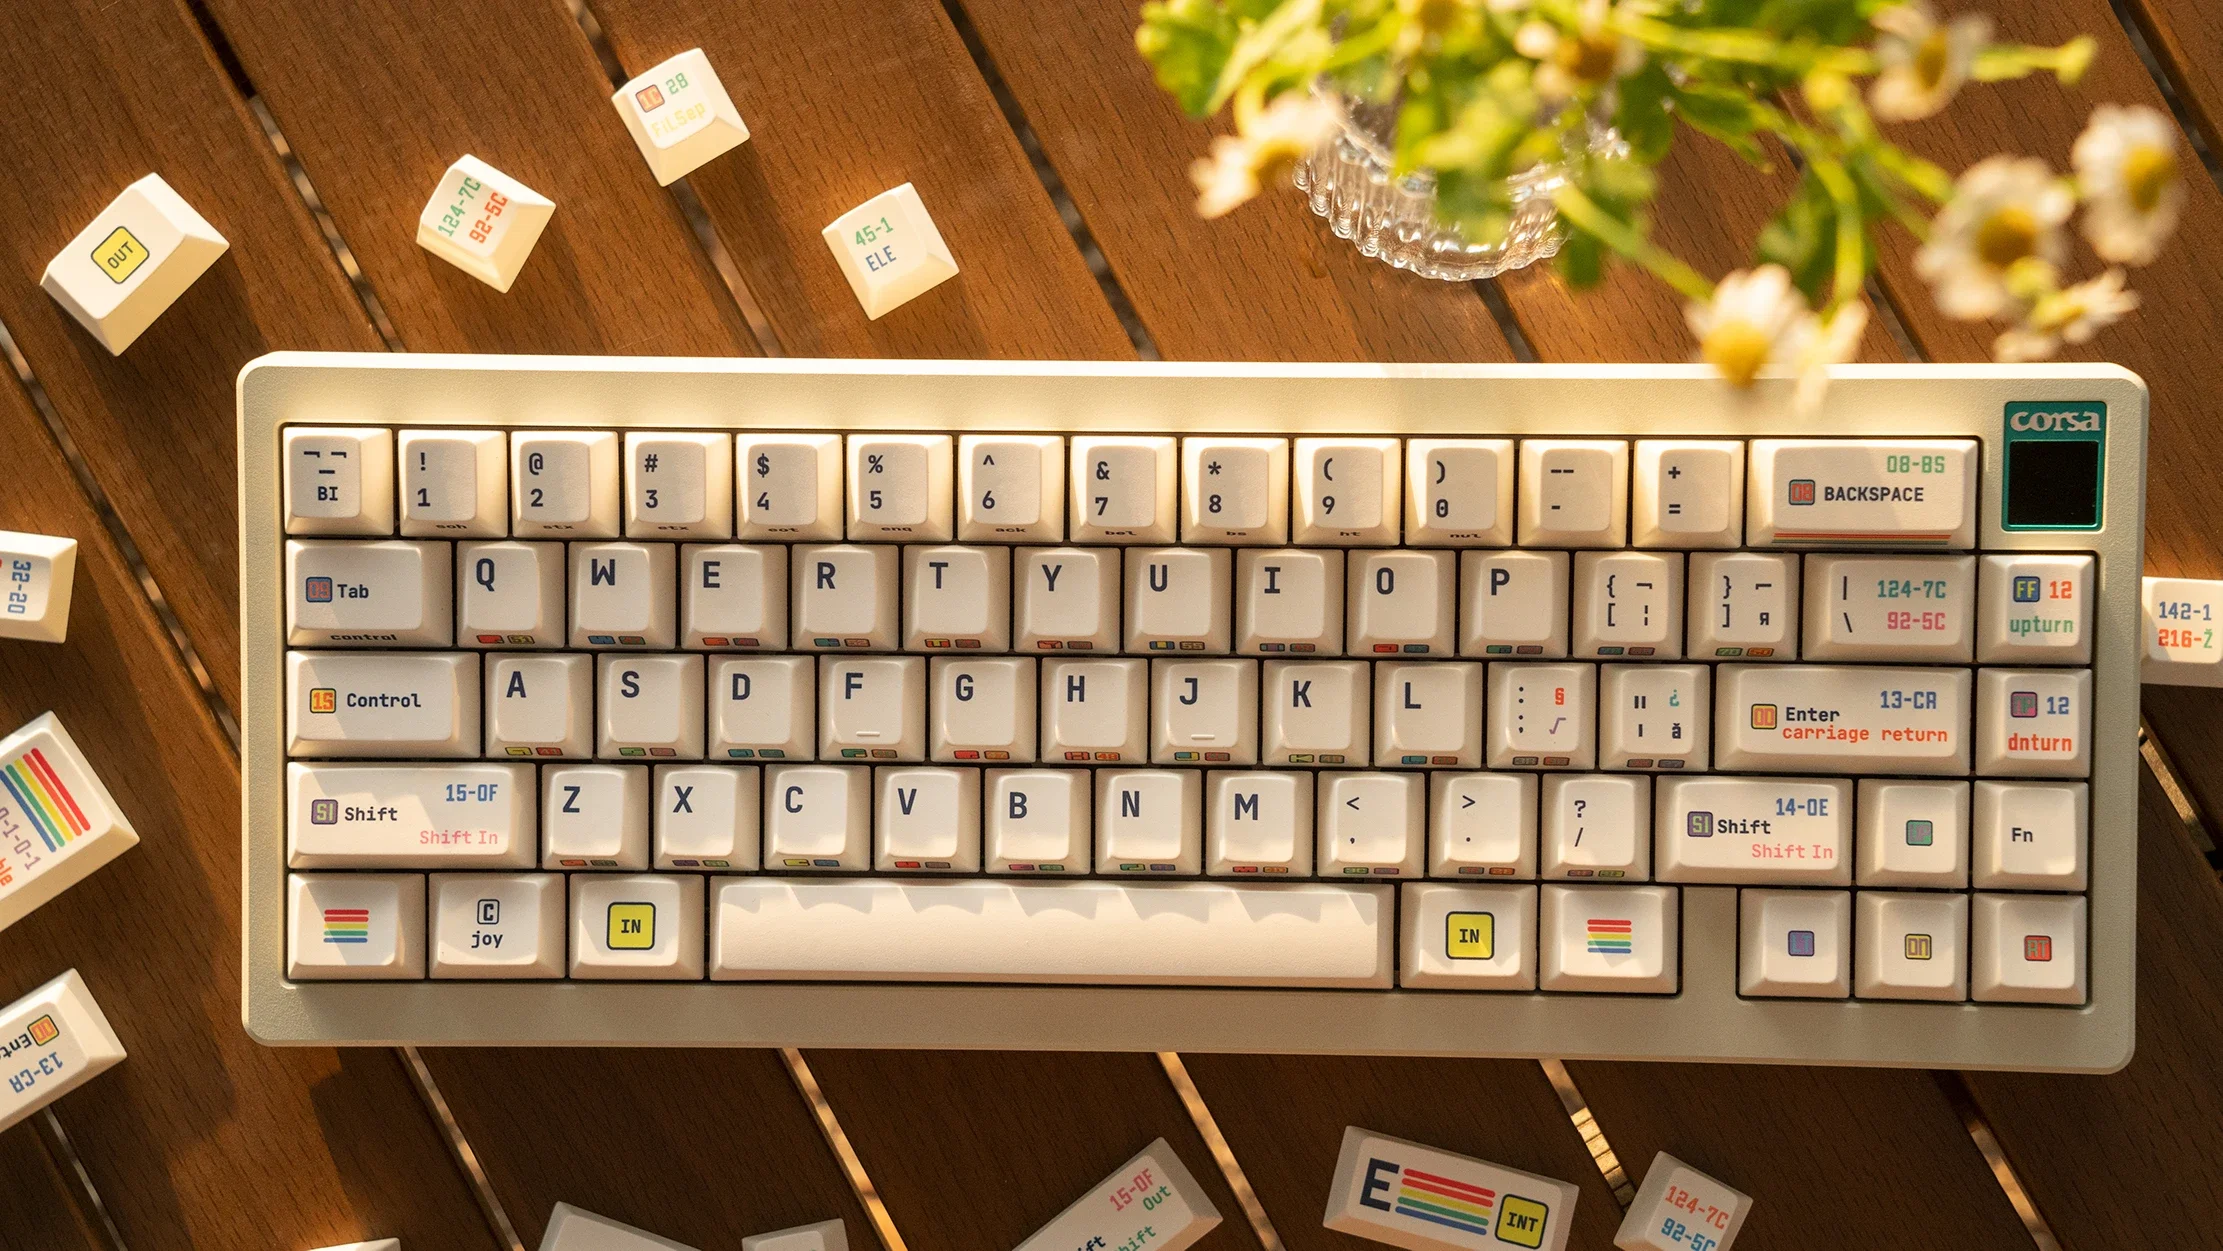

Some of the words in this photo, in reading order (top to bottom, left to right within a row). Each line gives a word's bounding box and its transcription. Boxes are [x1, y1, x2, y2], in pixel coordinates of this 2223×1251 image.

[666, 73, 688, 95] 28
[438, 177, 481, 237] 124-7C
[468, 192, 508, 244] 92-5C
[855, 217, 894, 246] 45-1
[107, 240, 134, 269] OUT
[865, 245, 897, 272] ELE
[2009, 411, 2101, 432] corsa
[421, 452, 426, 471] !
[529, 453, 543, 475] @
[645, 454, 658, 472] #
[757, 453, 769, 478] $
[868, 455, 883, 473] %
[983, 455, 994, 465] ^
[1096, 461, 1109, 480] &
[1324, 458, 1332, 481] (
[1887, 456, 1945, 473] 08-BS
[1437, 461, 1445, 484] )
[1668, 467, 1680, 479] +
[318, 486, 338, 501] BI
[418, 488, 430, 507] 1
[531, 489, 543, 507] 2
[646, 490, 658, 508] 3
[757, 492, 769, 510] 4
[871, 491, 882, 509] 5
[983, 491, 995, 509] 6
[1209, 495, 1221, 513] 8
[1825, 487, 1923, 501] BACKSPACE
[1095, 497, 1108, 515] 7
[1322, 496, 1335, 514] 9
[1436, 499, 1448, 518] 0
[1669, 504, 1680, 514] =
[476, 558, 494, 591] Q
[592, 559, 615, 585] W
[703, 561, 720, 588] E
[817, 562, 835, 589] R
[929, 562, 948, 589] T
[1042, 565, 1062, 591] Y
[1150, 565, 1167, 592] U
[1264, 567, 1280, 593] I
[1377, 568, 1394, 594] O
[1491, 568, 1510, 595] P
[7, 560, 32, 614] 32-20
[337, 584, 368, 598] Tab
[1878, 580, 1946, 598] 124-7C
[2017, 580, 2037, 599] FF
[2050, 581, 2072, 599] 12
[1888, 612, 1945, 630] 92-5C
[2159, 602, 2211, 620] 142-1
[2010, 616, 2072, 637] upturn
[507, 671, 526, 698] A
[621, 671, 639, 698] S
[733, 673, 750, 700] D
[846, 672, 863, 699] F
[956, 674, 973, 701] G
[1068, 675, 1085, 702] H
[1180, 678, 1198, 705] J
[1293, 681, 1311, 707] K
[347, 693, 421, 707] Control
[1405, 682, 1421, 709] L
[1881, 691, 1936, 709] 13-CR
[2047, 697, 2069, 714] 12
[1786, 707, 1839, 722] Enter
[1783, 725, 1869, 743] carriage
[1882, 728, 1947, 741] return
[2008, 733, 2071, 751] dnturn
[563, 786, 580, 813] Z
[673, 786, 693, 813] X
[786, 786, 803, 813] C
[898, 788, 917, 815] V
[1010, 792, 1027, 818] B
[1122, 791, 1139, 817] N
[1235, 794, 1258, 820] M
[1575, 800, 1586, 818] ?
[345, 807, 397, 821] Shift
[420, 830, 471, 844] Shift
[479, 831, 497, 844] In
[1718, 819, 1770, 834] Shift
[2012, 828, 2032, 842] Fn
[1752, 844, 1805, 858] Shift
[1813, 845, 1832, 859] In
[483, 903, 494, 921] C
[621, 919, 641, 933] IN
[1460, 929, 1479, 943] IN
[472, 931, 503, 948] joy
[0, 1033, 32, 1059] Ent
[9, 1051, 63, 1093] 13-CR
[1143, 1185, 1171, 1211] Out
[1359, 1157, 1400, 1212] E
[1505, 1211, 1539, 1233] INT
[1665, 1185, 1729, 1230] 124-7C
[1661, 1217, 1716, 1251] 92-5C
